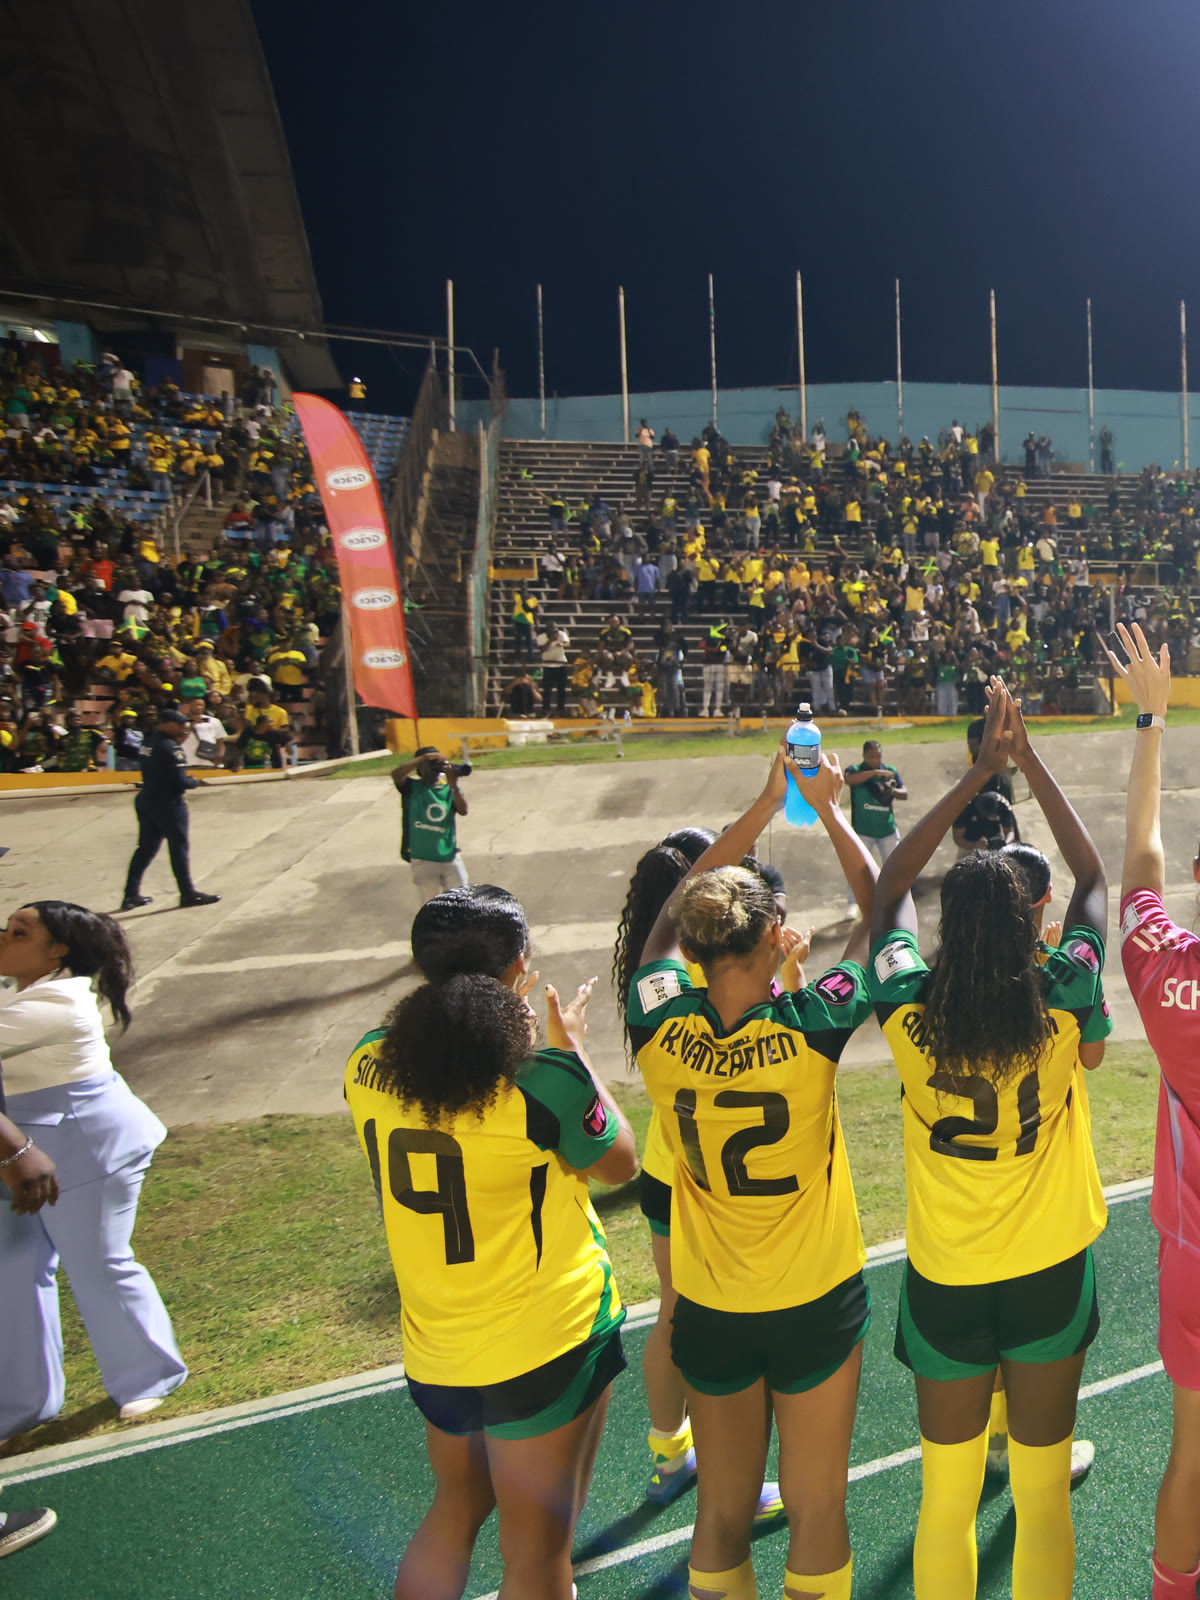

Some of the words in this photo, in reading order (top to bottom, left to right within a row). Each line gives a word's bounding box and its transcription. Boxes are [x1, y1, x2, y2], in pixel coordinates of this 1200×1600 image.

[673, 1088, 801, 1197] 12
[926, 1068, 1042, 1162] 21
[363, 1118, 475, 1266] 19
